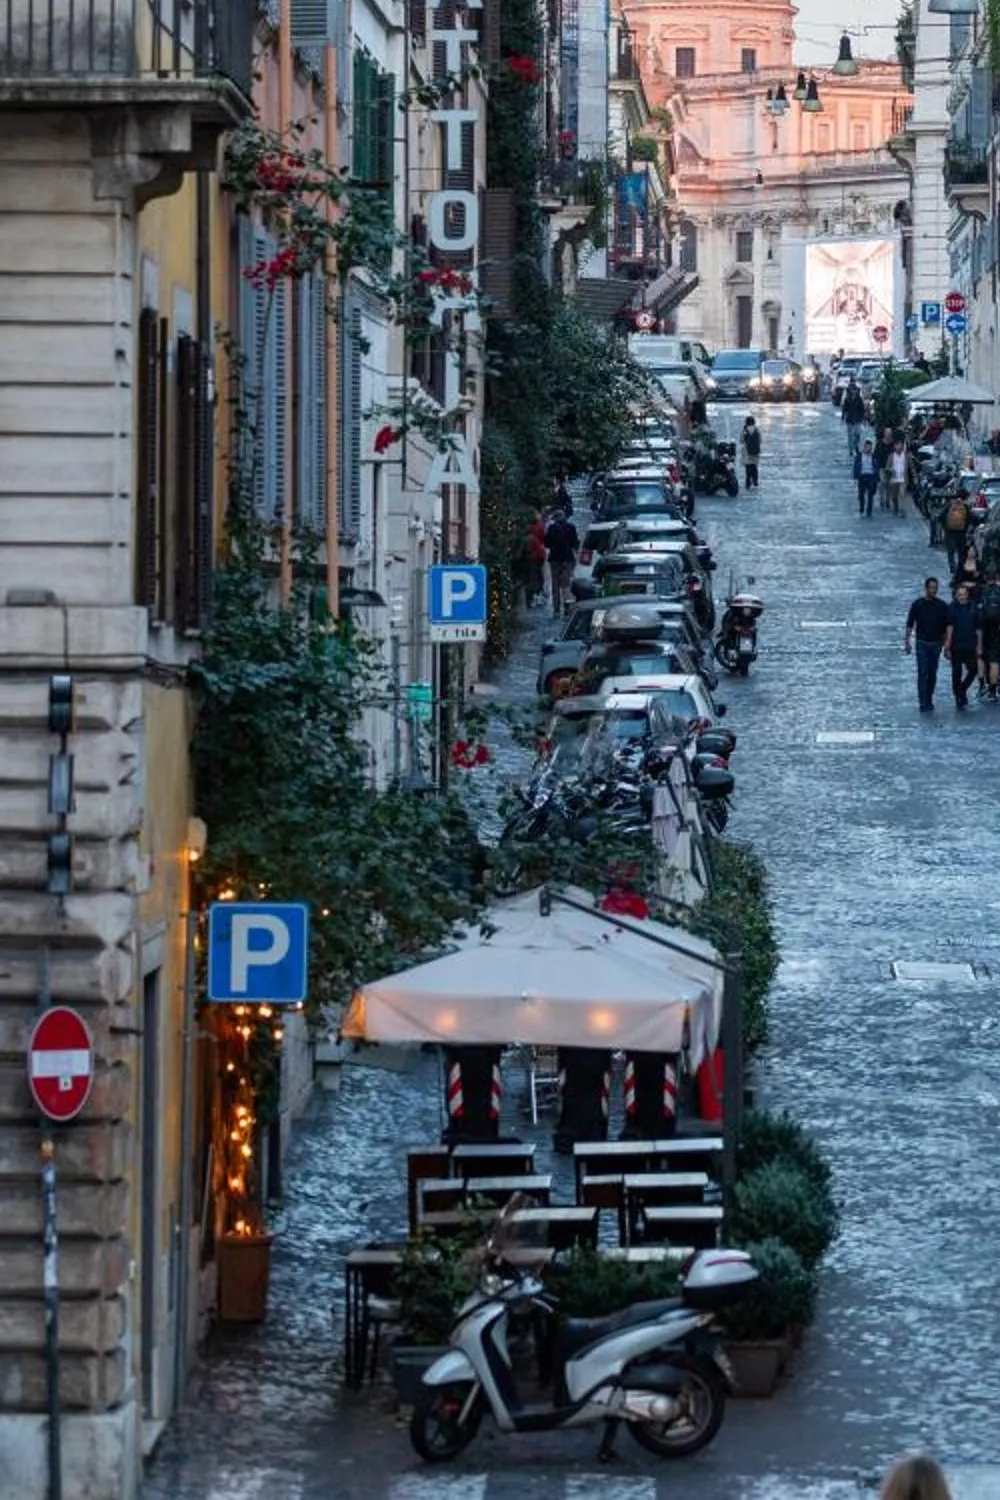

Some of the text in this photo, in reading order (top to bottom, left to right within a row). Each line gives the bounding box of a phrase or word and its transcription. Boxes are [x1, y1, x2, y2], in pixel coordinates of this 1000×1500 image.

[925, 304, 937, 321] P
[441, 572, 476, 617] P
[230, 913, 290, 992] P
